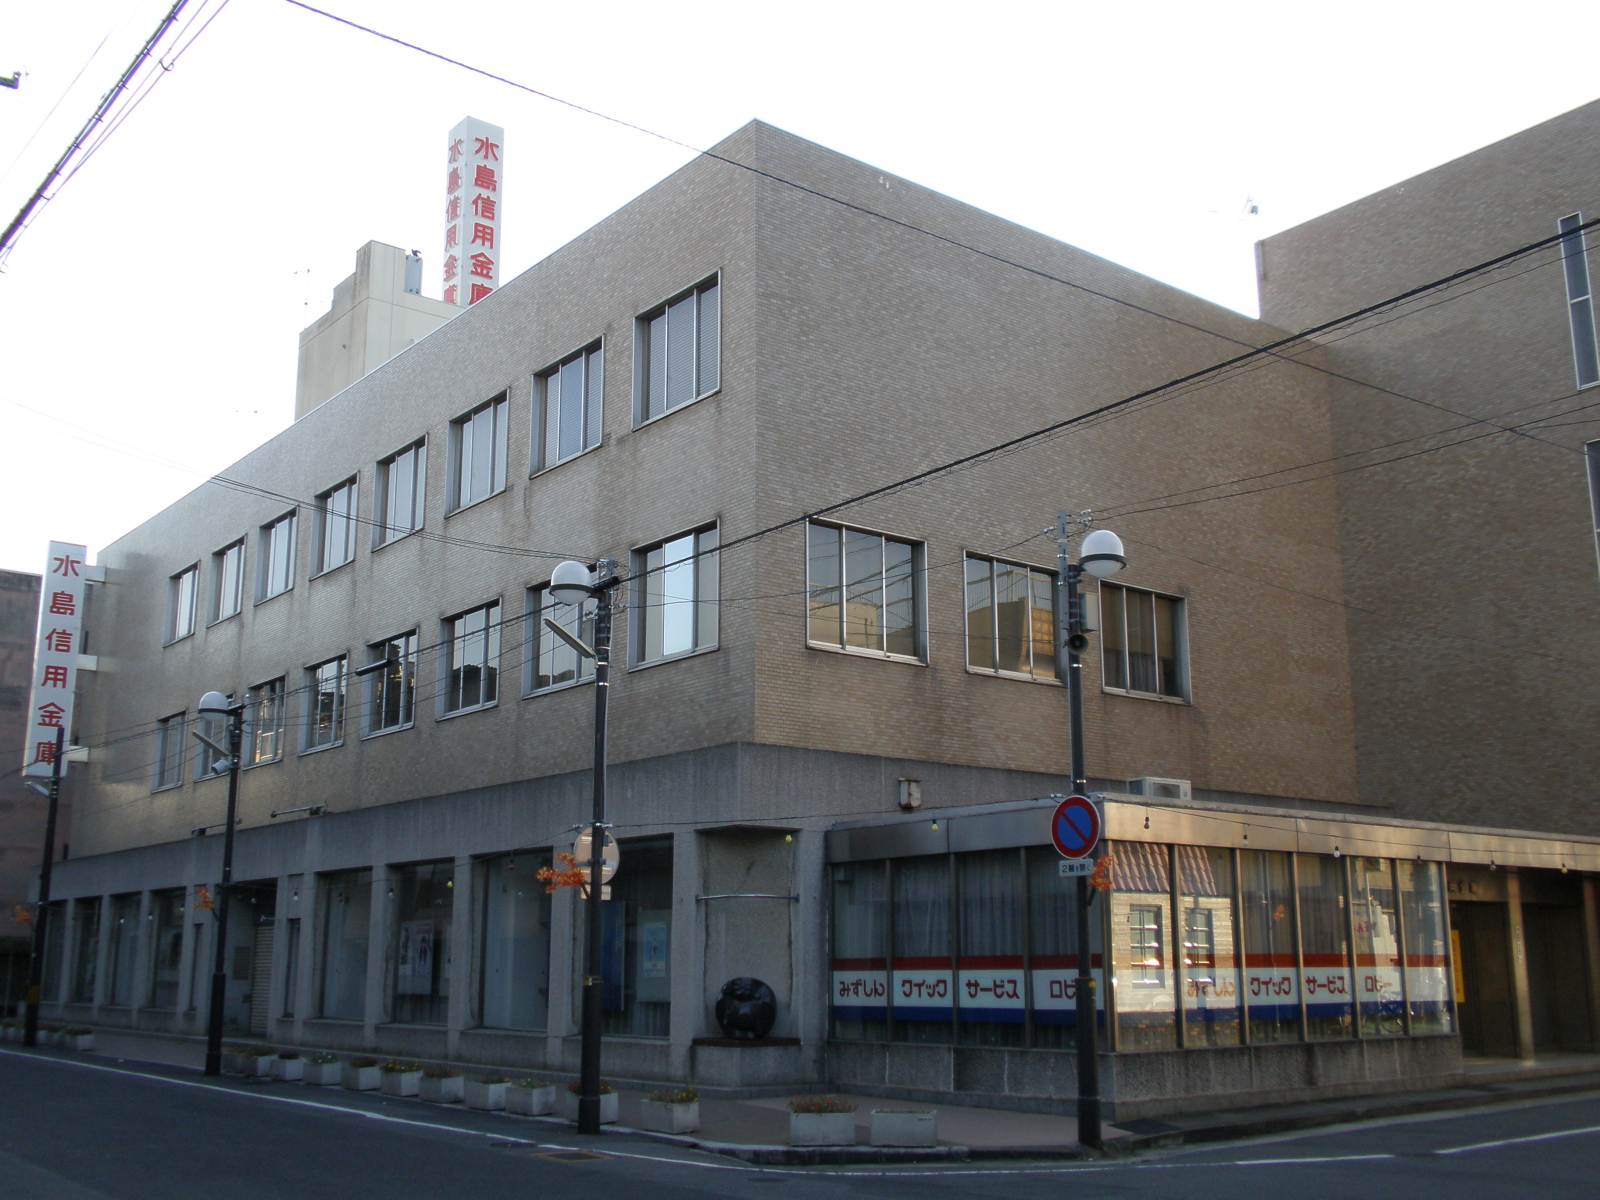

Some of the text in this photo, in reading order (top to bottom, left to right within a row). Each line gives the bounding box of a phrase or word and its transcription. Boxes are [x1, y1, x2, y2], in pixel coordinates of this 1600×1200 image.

[469, 136, 500, 305] 水島信用金庫
[34, 554, 81, 766] 水島信用金庫
[839, 978, 1076, 999] みずしん クイック サービス ロビ
[1250, 976, 1292, 996] クイック
[1305, 975, 1348, 996] サービス
